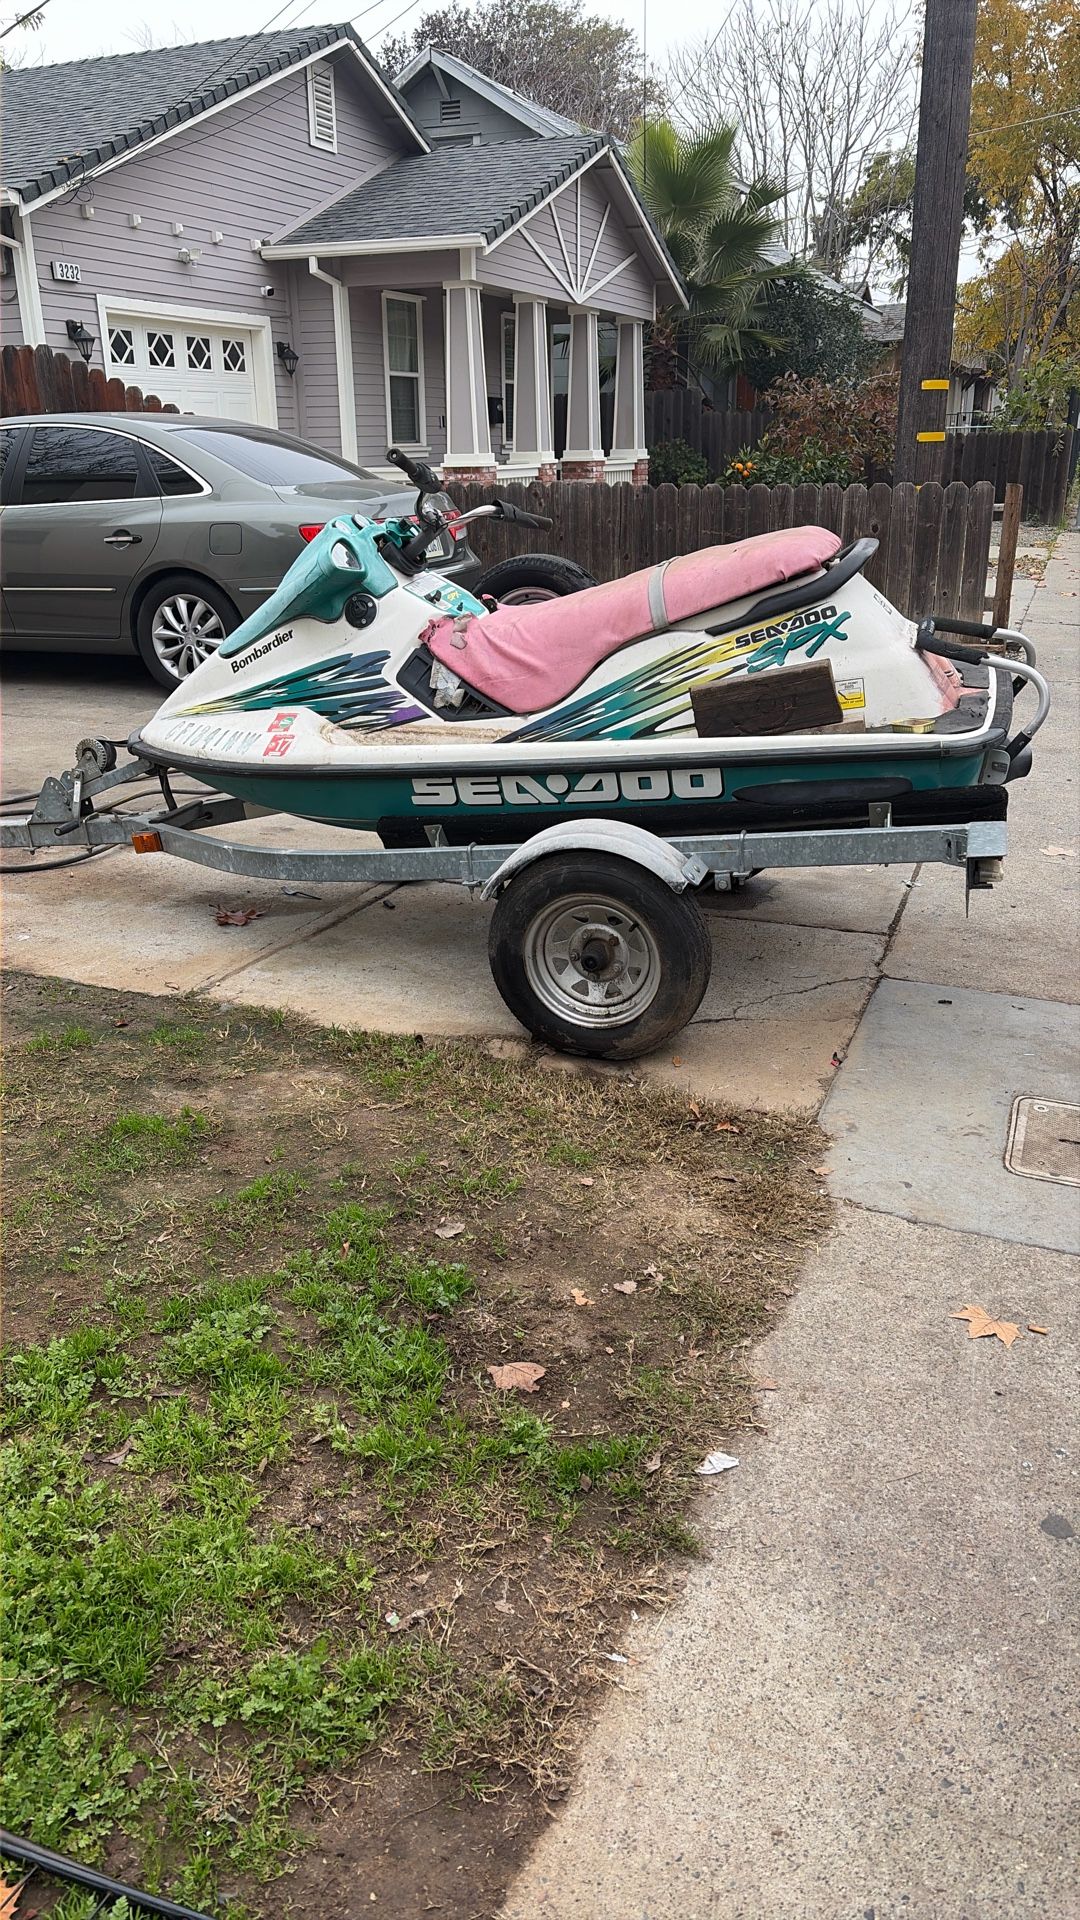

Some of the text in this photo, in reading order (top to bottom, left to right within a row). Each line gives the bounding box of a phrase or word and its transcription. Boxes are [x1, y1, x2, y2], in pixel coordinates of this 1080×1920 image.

[59, 263, 80, 280] 3232
[230, 628, 295, 674] Bombardier
[746, 611, 852, 674] SPX
[275, 738, 293, 752] 17
